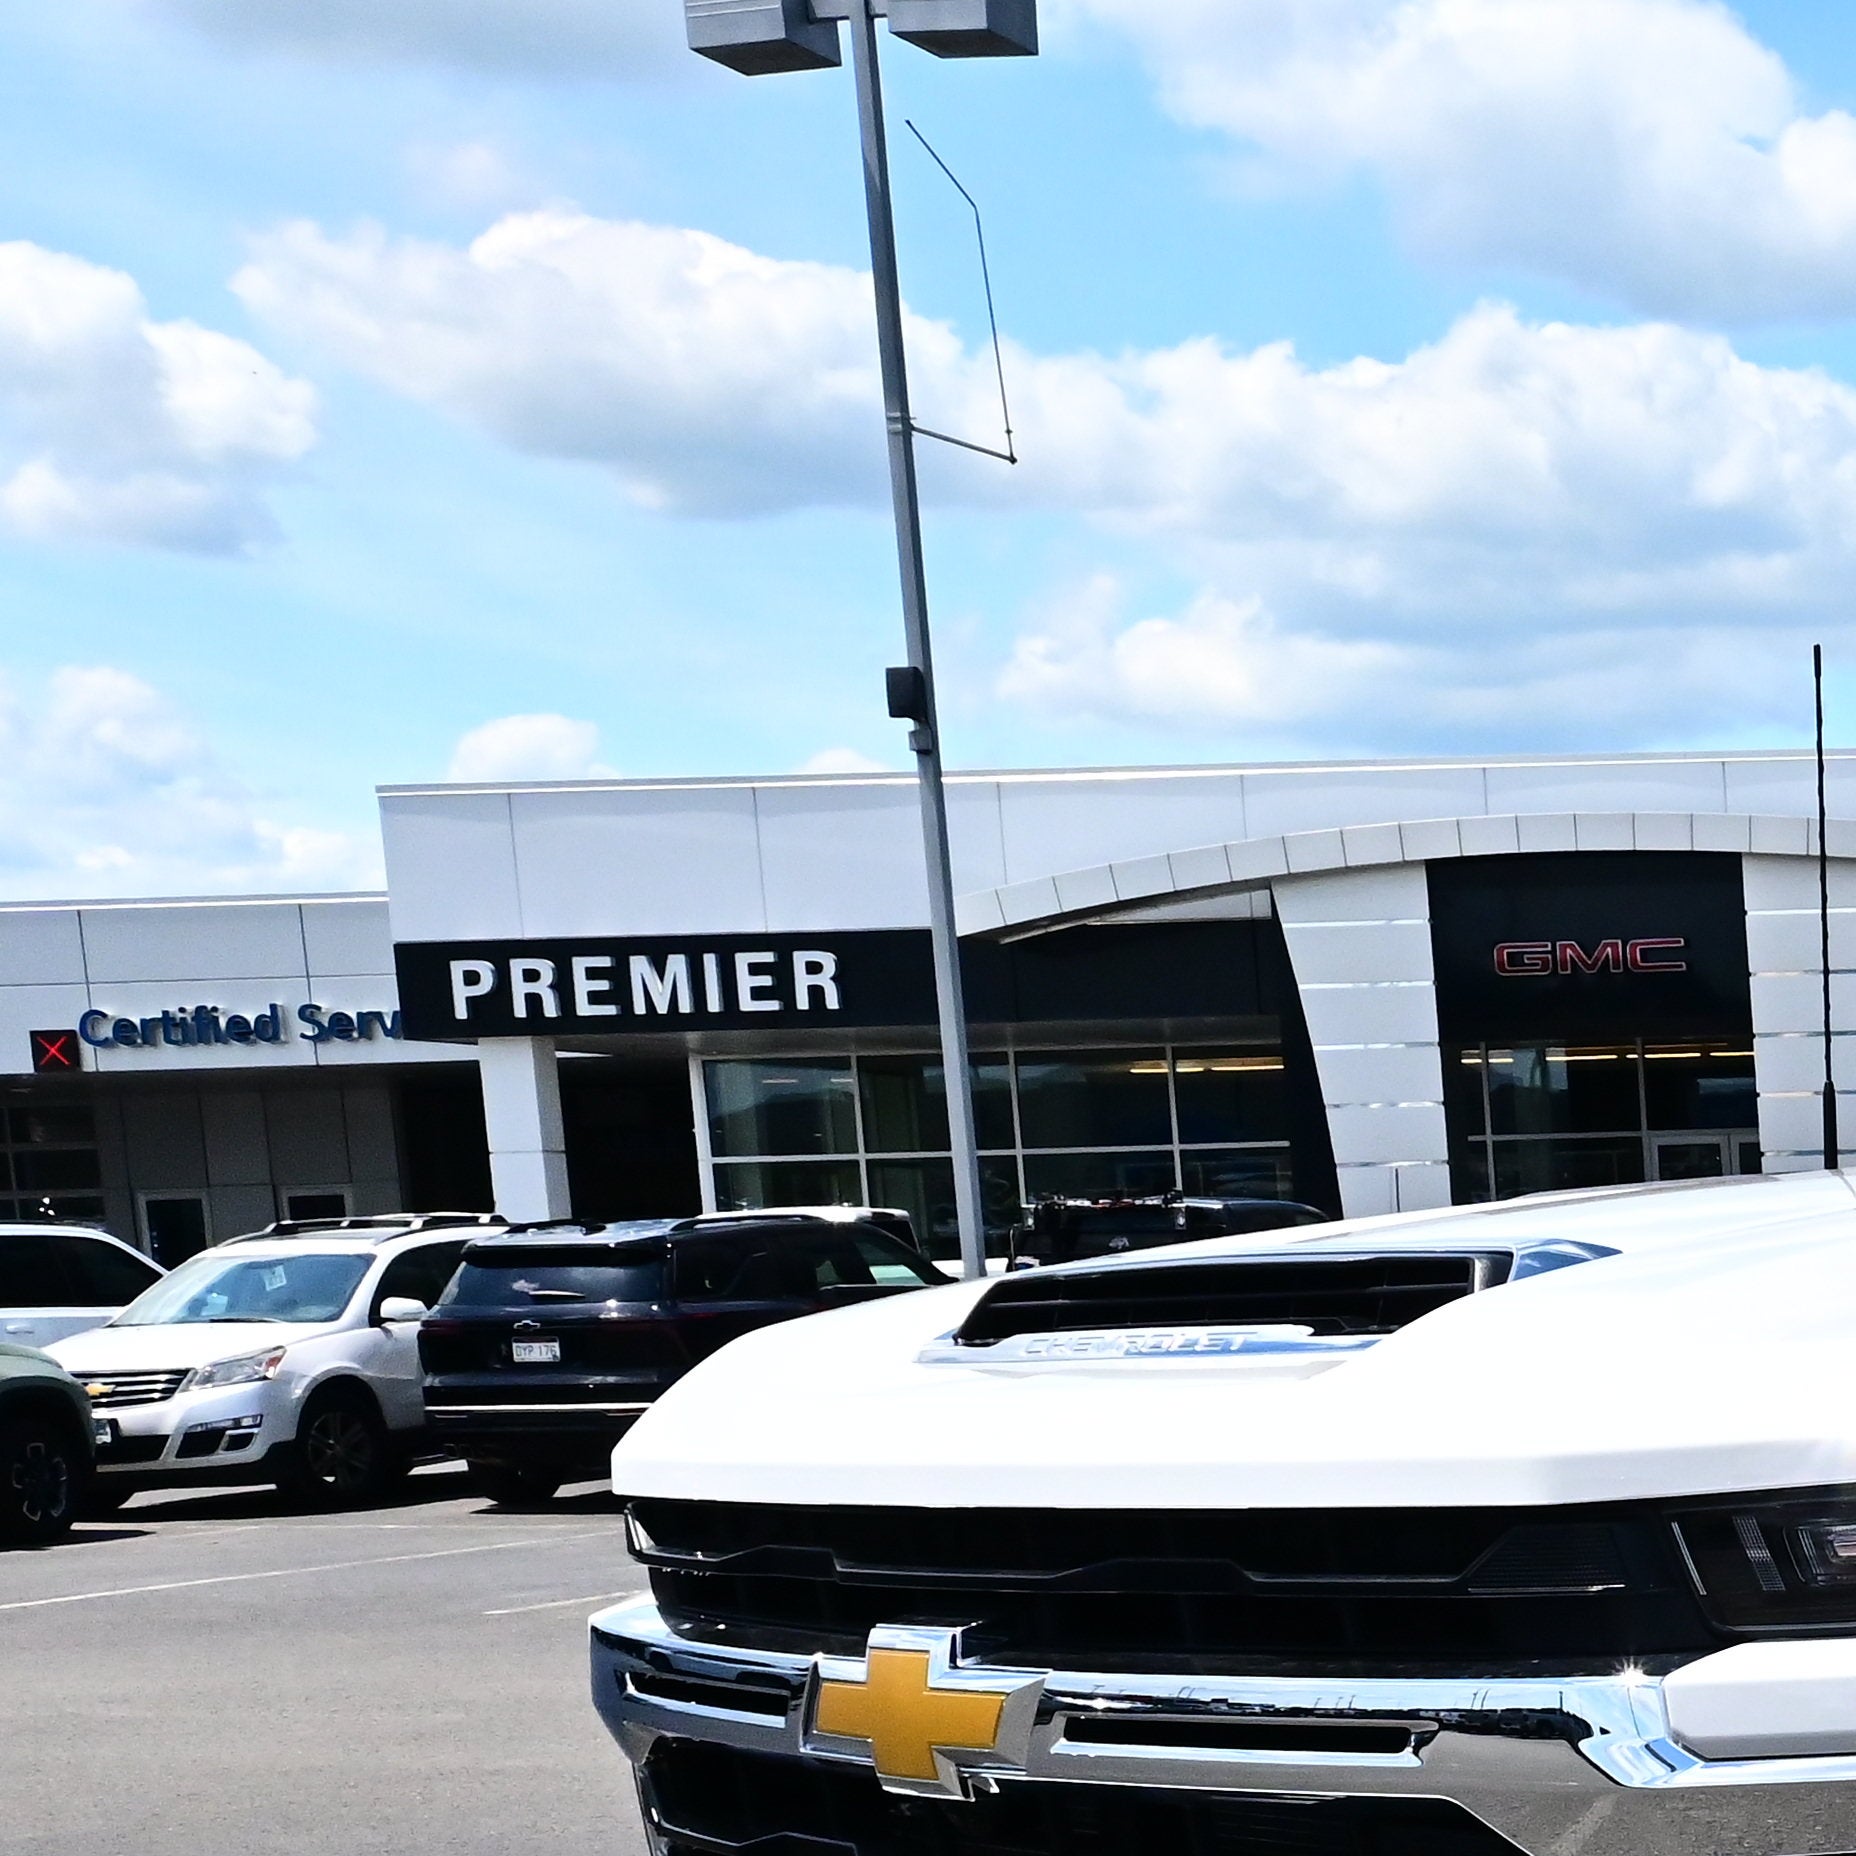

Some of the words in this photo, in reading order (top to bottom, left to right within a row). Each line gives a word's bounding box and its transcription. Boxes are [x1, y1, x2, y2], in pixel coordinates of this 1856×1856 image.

[1493, 937, 1687, 976] GMC
[449, 950, 841, 1020] PREMIER
[79, 1003, 282, 1048] Certified
[1022, 1331, 1258, 1356] CHEVROLET
